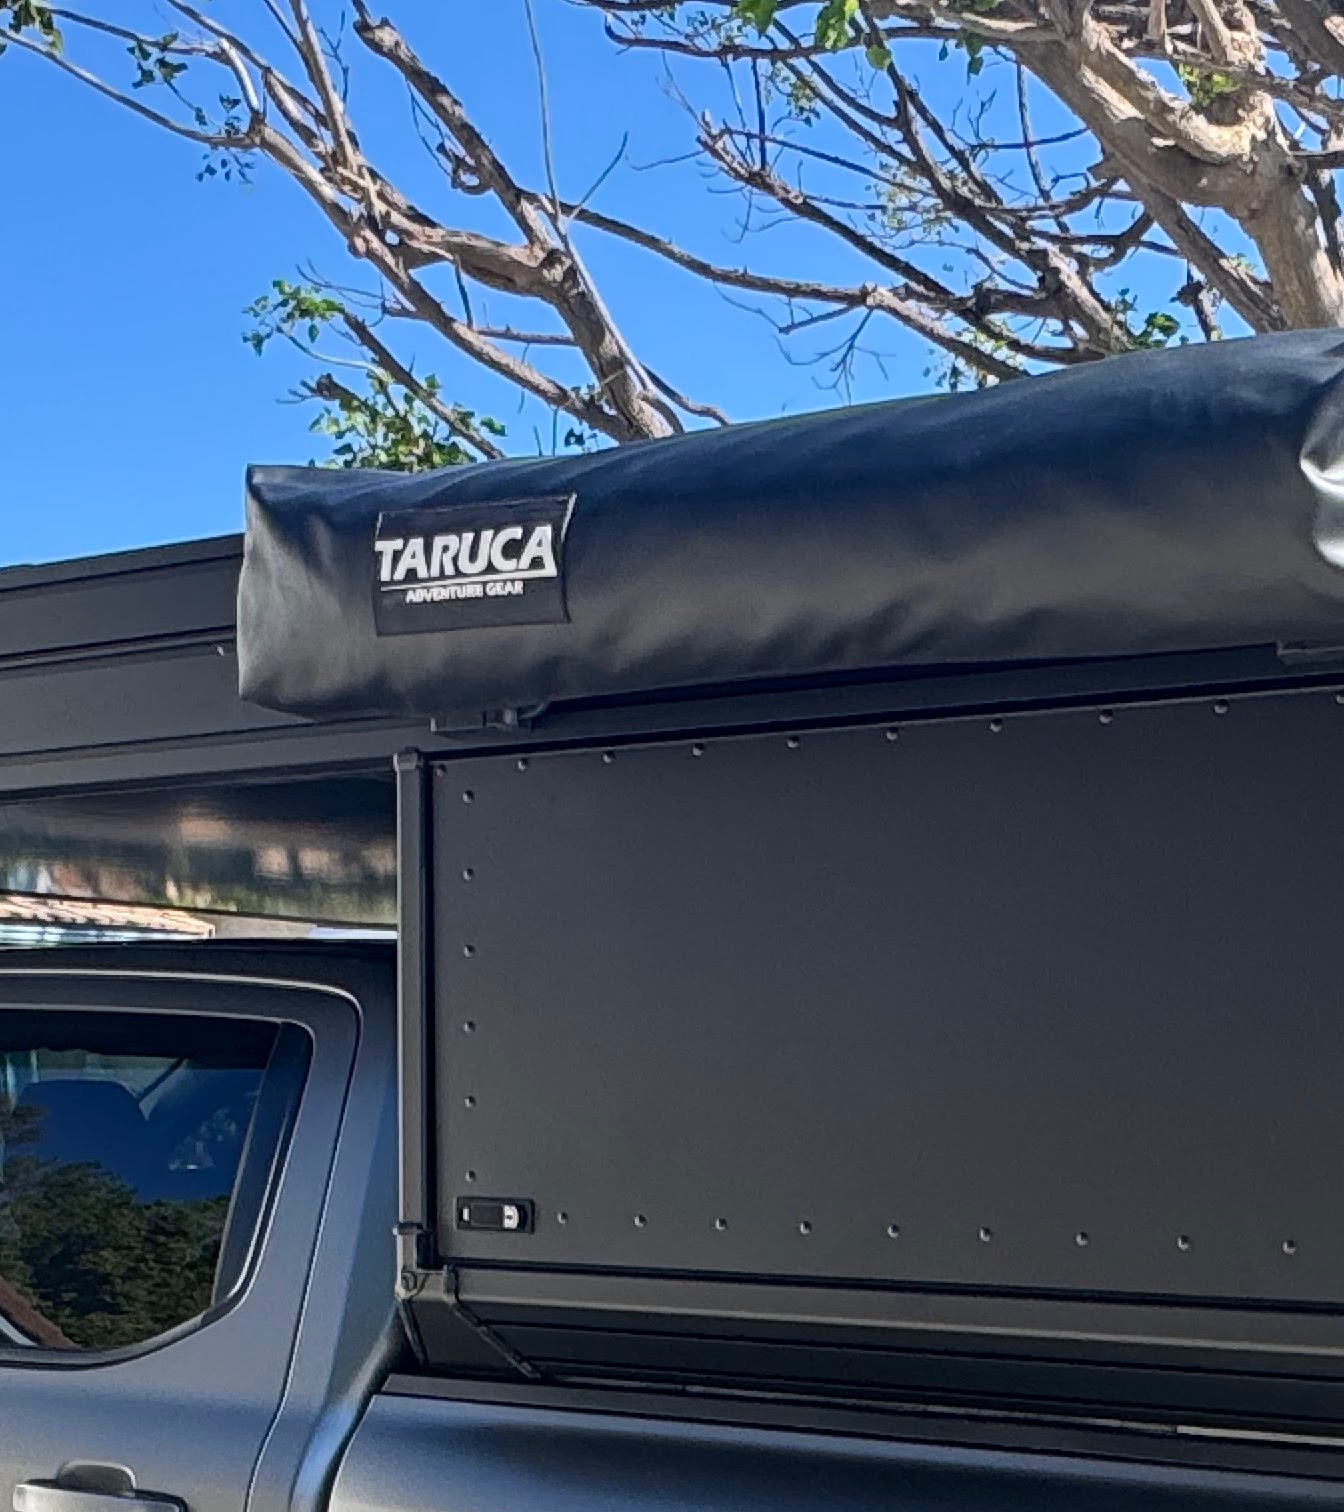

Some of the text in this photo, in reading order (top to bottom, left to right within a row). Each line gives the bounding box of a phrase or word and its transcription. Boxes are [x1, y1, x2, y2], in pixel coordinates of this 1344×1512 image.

[375, 525, 557, 582] TARUCA
[406, 581, 525, 604] ADVENTURE GEAR
